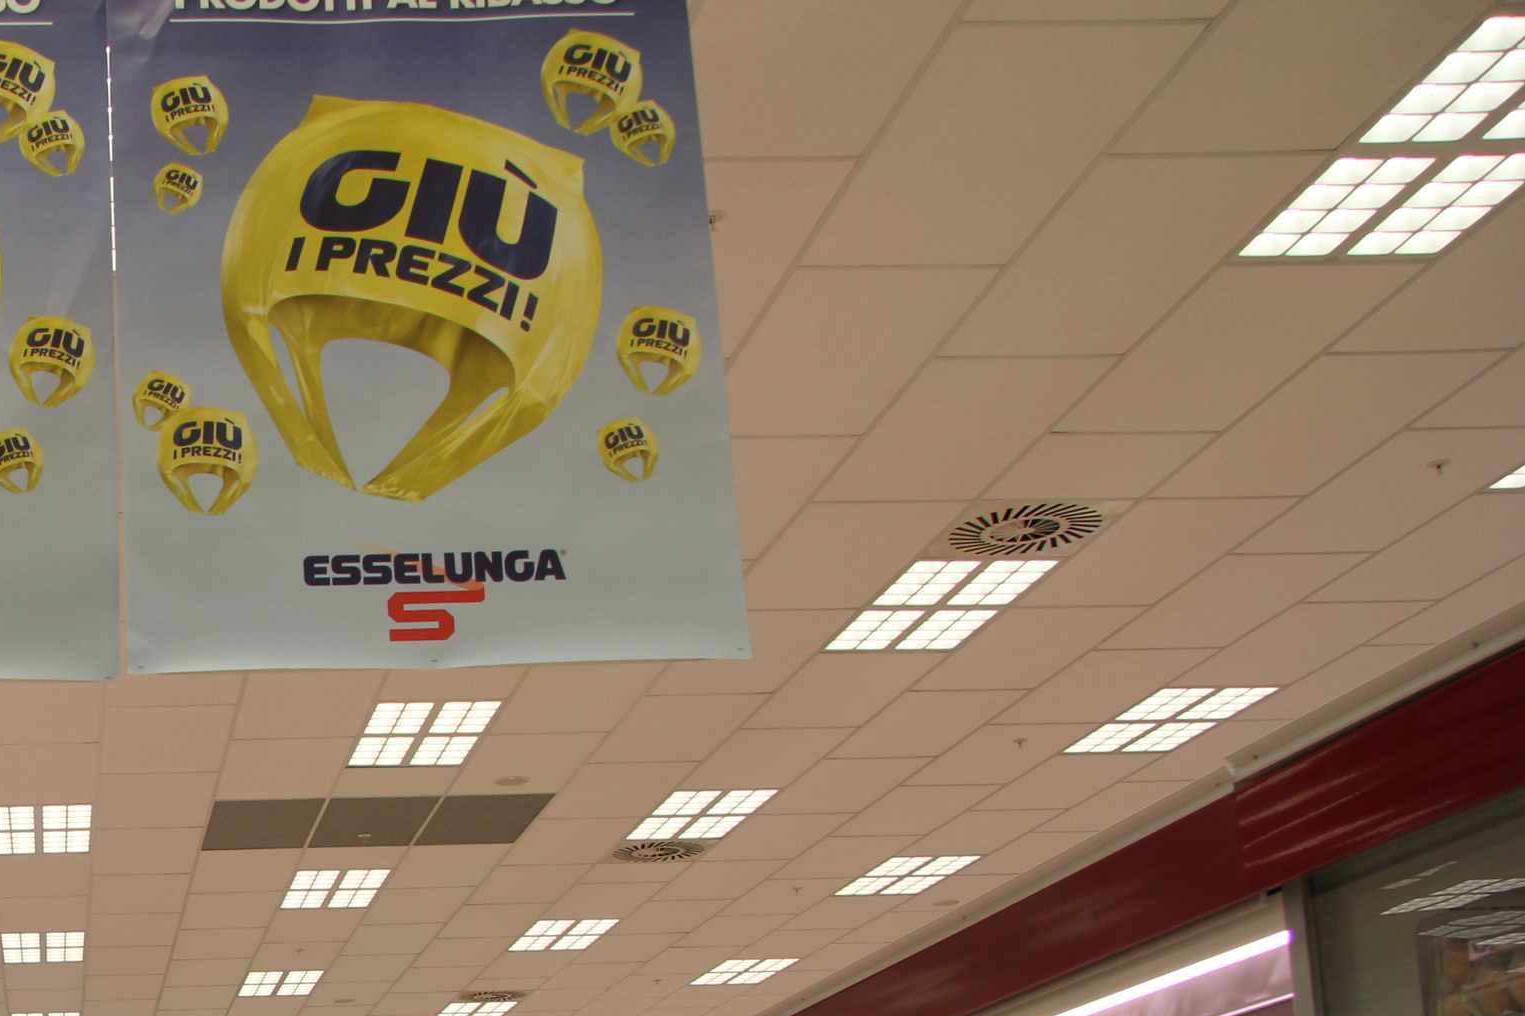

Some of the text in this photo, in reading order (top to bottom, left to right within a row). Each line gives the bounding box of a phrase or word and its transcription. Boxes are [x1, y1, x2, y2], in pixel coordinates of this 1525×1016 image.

[563, 44, 632, 83] GIÙ
[160, 82, 212, 113] GIÙ
[27, 116, 70, 143] GIÙ
[300, 150, 557, 281] GIÙ
[284, 236, 539, 332] I PREZZI!
[27, 328, 85, 358] GIÙ
[632, 318, 690, 348] GIÙ
[147, 379, 185, 404] GIÙ
[173, 417, 242, 450] GIÙ
[604, 423, 644, 449] GIÙ
[303, 548, 566, 586] ESSELUNGA
